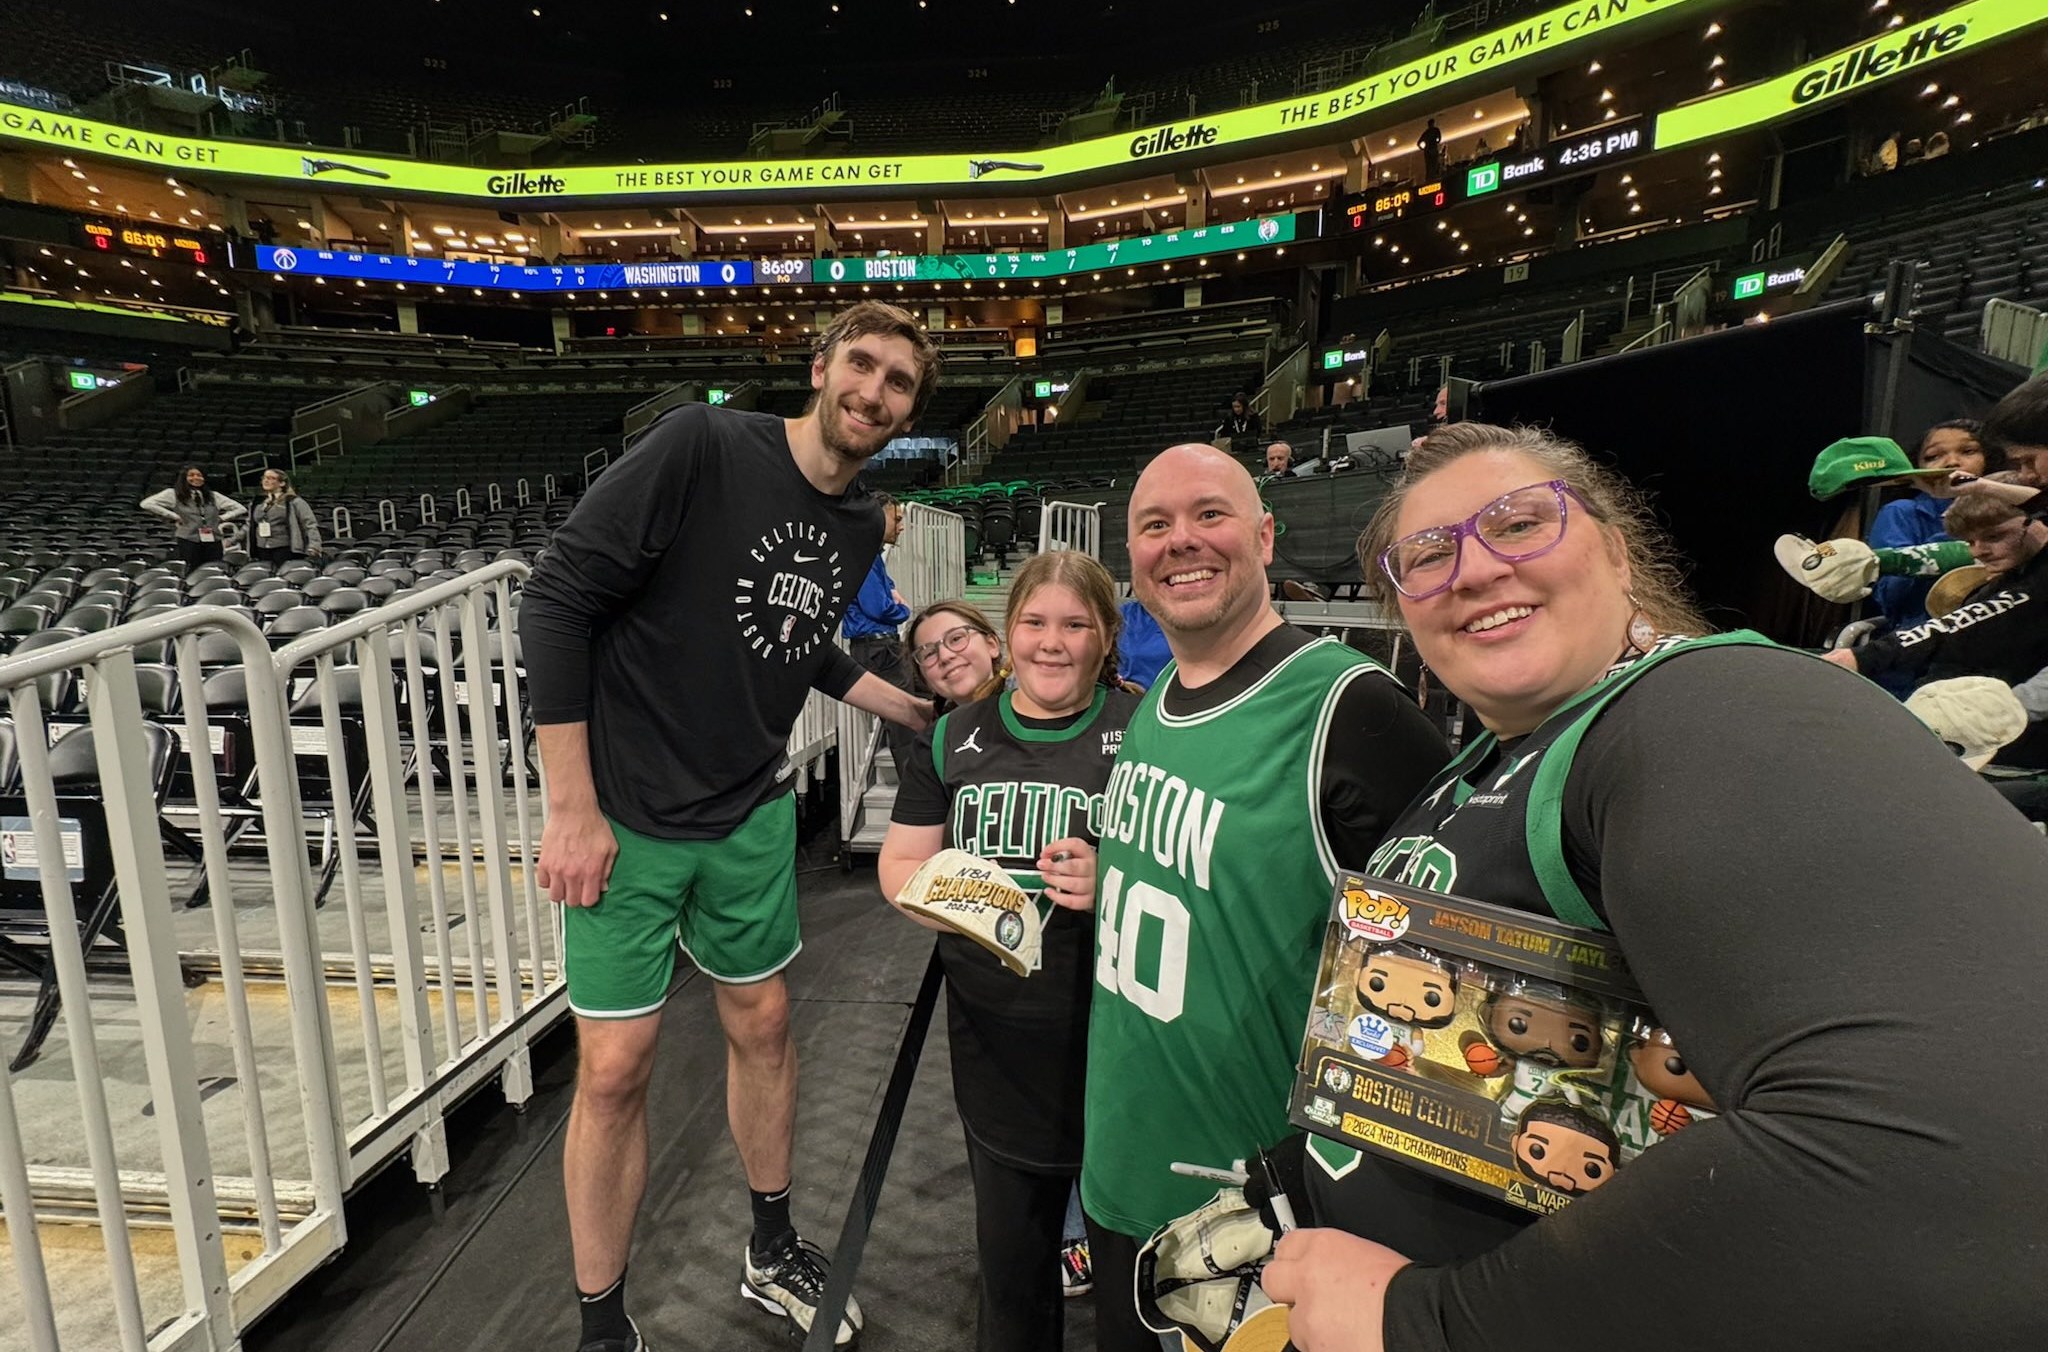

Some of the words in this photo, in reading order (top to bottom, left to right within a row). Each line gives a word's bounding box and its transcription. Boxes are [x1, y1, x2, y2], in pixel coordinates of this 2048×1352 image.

[1280, 103, 1320, 125] THE
[1328, 83, 1380, 116] BEST
[1388, 56, 1457, 95] YOUR
[1469, 20, 1552, 65] GAME
[1563, 0, 1629, 32] CAN
[1792, 23, 1967, 103] Gillette
[3, 113, 93, 143] GAME
[105, 133, 164, 156] CAN
[176, 145, 219, 163] GET
[1130, 123, 1218, 158] Gillette
[1559, 141, 1601, 166] 4:36
[1606, 130, 1639, 154] PM
[616, 173, 647, 187] THE
[655, 171, 695, 186] BEST
[700, 169, 752, 184] YOUR
[760, 166, 814, 182] GAME
[821, 165, 861, 179] CAN
[868, 164, 903, 178] GET
[1503, 156, 1545, 180] Bank
[487, 173, 566, 194] Gillette
[1375, 191, 1410, 212] 86:09
[1435, 192, 1444, 206] 0
[1353, 215, 1361, 227] 0
[123, 230, 167, 248] 86:09
[1193, 230, 1207, 238] AST
[624, 264, 700, 284] WASHINGTON
[721, 264, 735, 283] 0
[761, 259, 804, 275] 86:09
[830, 261, 845, 280] 0
[865, 259, 916, 278] BOSTON
[989, 265, 996, 275] 0
[1011, 264, 1018, 275] 7
[1509, 266, 1524, 280] 19
[1767, 267, 1805, 287] Bank
[555, 276, 562, 286] 7
[577, 276, 585, 286] 0
[1344, 350, 1367, 362] Bank
[751, 522, 828, 563] CELTICS
[767, 572, 825, 620] CELTICS
[783, 551, 843, 664] BASKETBALL
[734, 578, 774, 660] BOSTON
[1101, 730, 1126, 744] VIS
[955, 867, 992, 880] NBA
[924, 875, 1026, 914] CHAMPIONS
[944, 902, 986, 915] 2023-24
[1429, 910, 1492, 941] JAYSON
[1495, 926, 1550, 955] TATUM
[1096, 865, 1191, 1023] 40
[1531, 1077, 1543, 1092] 7
[1352, 1073, 1414, 1117] BOSTON
[1417, 1096, 1482, 1140] CELTICS
[1352, 1119, 1376, 1139] 2024
[1380, 1128, 1400, 1149] NBA
[1403, 1138, 1468, 1172] CHAMPIONS
[1505, 1193, 1527, 1206] Small
[1527, 1202, 1547, 1214] parts.
[1537, 1189, 1571, 1211] WAR
